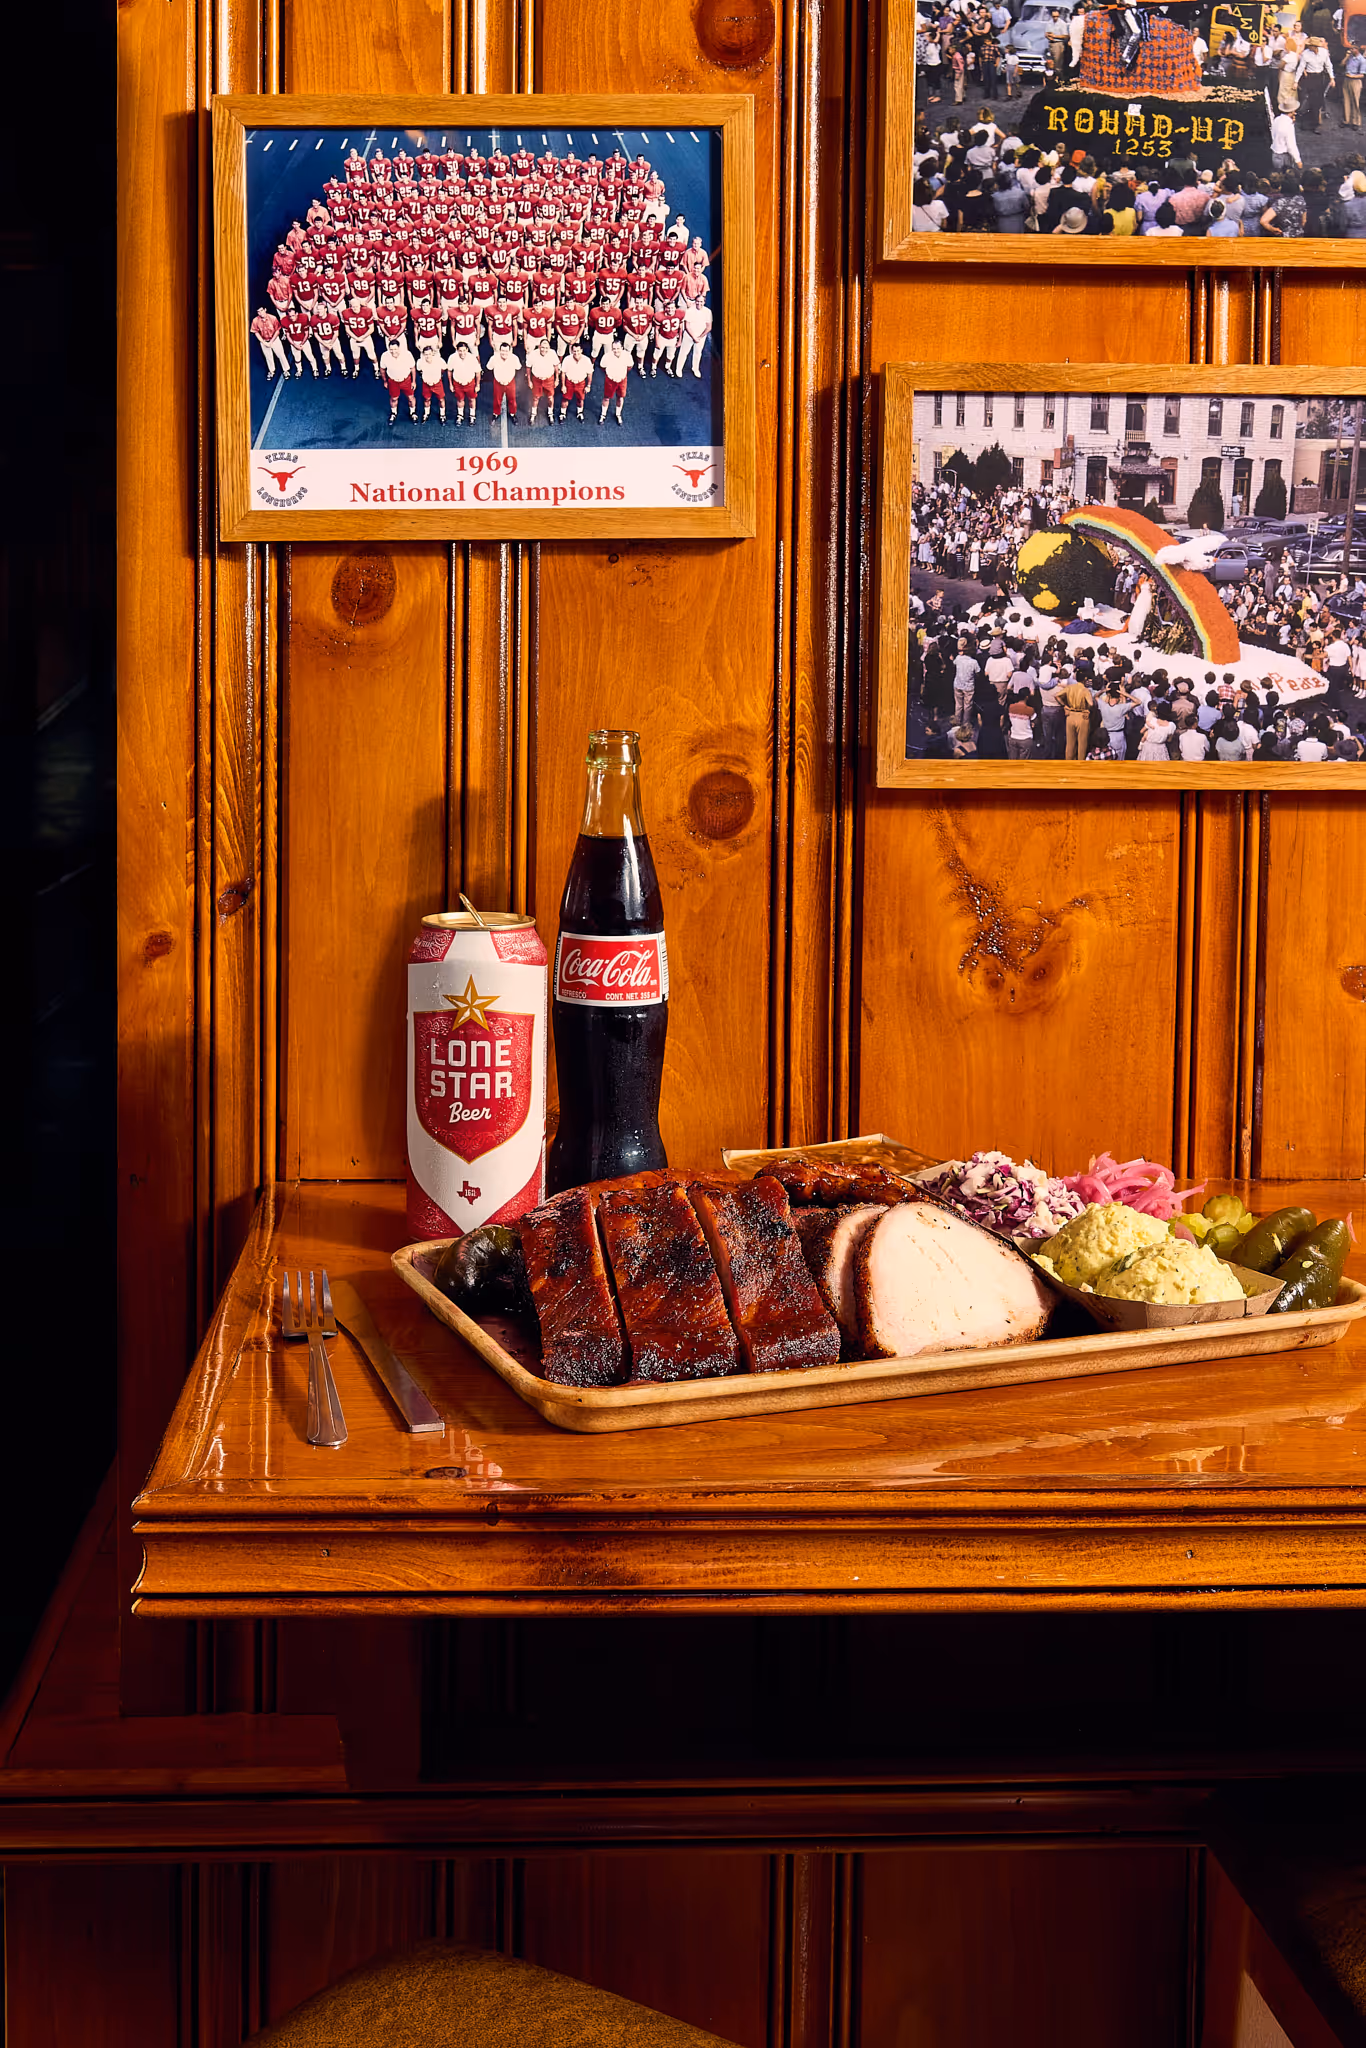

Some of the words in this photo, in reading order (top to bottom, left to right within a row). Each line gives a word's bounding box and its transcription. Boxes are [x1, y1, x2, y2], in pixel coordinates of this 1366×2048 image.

[1044, 105, 1245, 150] ROUND-UP
[1112, 138, 1174, 158] 1253
[350, 162, 362, 171] 82
[374, 164, 385, 174] 87
[399, 163, 408, 172] 11
[421, 164, 433, 173] 77
[446, 161, 459, 171] 50
[468, 163, 480, 172] 75
[493, 163, 505, 172] 79
[516, 159, 529, 169] 60
[542, 164, 554, 174] 57
[564, 165, 577, 175] 47
[448, 185, 460, 195] 58
[474, 185, 487, 196] 52
[552, 185, 564, 195] 39
[580, 184, 592, 193] 53
[607, 185, 615, 196] 2
[627, 185, 639, 195] 36
[333, 205, 346, 215] 42
[409, 202, 421, 214] 71
[435, 205, 448, 214] 62
[460, 205, 475, 215] 80
[488, 204, 502, 214] 65
[517, 201, 531, 212] 70
[569, 202, 582, 212] 78
[357, 208, 370, 220] 17
[383, 209, 397, 220] 72
[368, 230, 383, 241] 55
[395, 231, 408, 240] 49
[420, 227, 434, 237] 54
[448, 230, 461, 241] 46
[475, 226, 489, 238] 38
[505, 231, 518, 242] 79
[532, 230, 546, 242] 35
[560, 230, 574, 240] 85
[590, 228, 605, 239] 29
[618, 228, 629, 239] 41
[325, 253, 338, 264] 51
[351, 248, 367, 261] 73
[382, 251, 397, 264] 74
[436, 250, 449, 262] 14
[462, 251, 477, 264] 45
[492, 250, 506, 264] 40
[579, 250, 594, 263] 34
[639, 248, 652, 258] 12
[664, 250, 679, 261] 90
[301, 256, 315, 268] 56
[523, 255, 536, 268] 16
[550, 254, 564, 267] 28
[298, 281, 311, 293] 13
[381, 279, 397, 292] 32
[412, 279, 426, 290] 86
[440, 278, 456, 291] 76
[474, 280, 490, 293] 68
[506, 281, 522, 293] 66
[573, 280, 587, 294] 31
[606, 278, 621, 291] 55
[634, 280, 647, 292] 10
[661, 278, 677, 289] 20
[539, 283, 555, 296] 64
[349, 317, 365, 329] 53
[383, 316, 399, 327] 44
[418, 317, 434, 331] 22
[456, 314, 474, 328] 30
[494, 313, 512, 328] 24
[529, 317, 546, 329] 84
[562, 313, 579, 326] 59
[598, 316, 614, 327] 90
[631, 313, 647, 327] 55
[662, 318, 679, 332] 33
[288, 323, 301, 334] 17
[316, 322, 332, 335] 18
[265, 452, 299, 464] TEXAS
[679, 451, 711, 462] TEXAS
[456, 452, 518, 476] 1969
[256, 486, 308, 508] LONGHORNS
[349, 481, 466, 503] National
[473, 480, 626, 506] Champions
[561, 948, 655, 988] Coca-Cola
[561, 988, 587, 999] REFRESCO
[605, 992, 624, 1001] CONT.
[625, 992, 639, 1000] NET.
[430, 1037, 512, 1068] LONE
[430, 1069, 514, 1099] STAR
[448, 1101, 492, 1124] Beer
